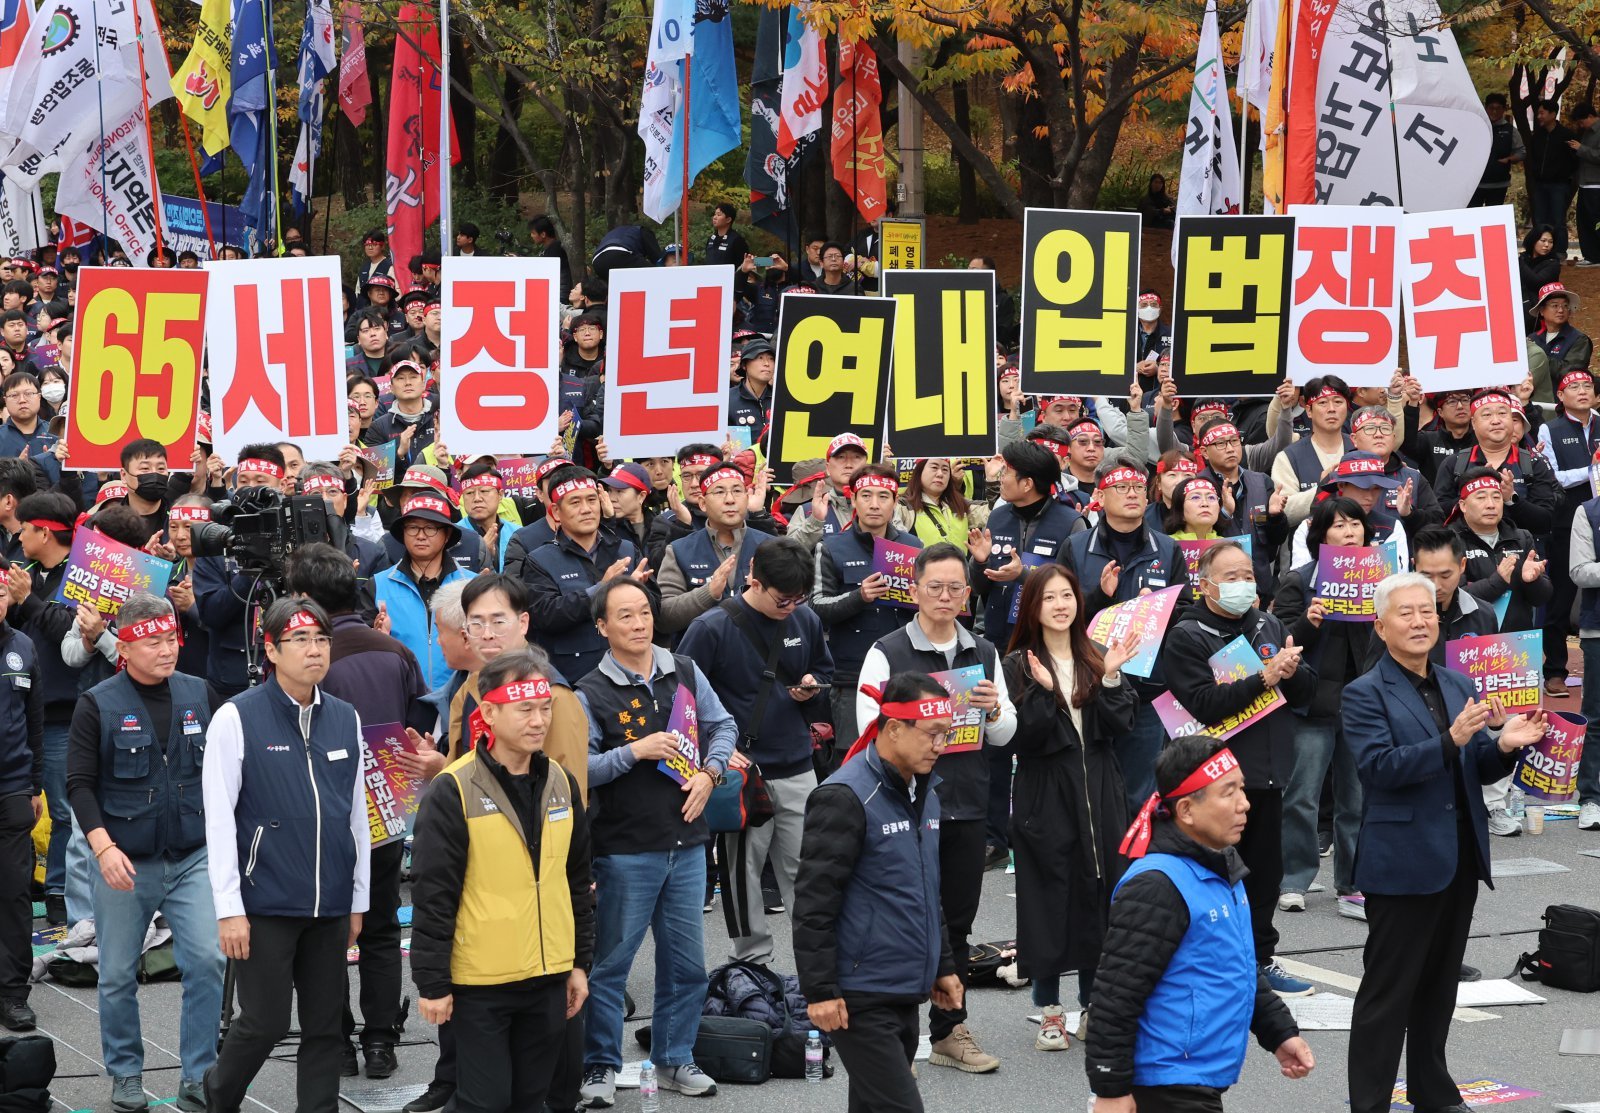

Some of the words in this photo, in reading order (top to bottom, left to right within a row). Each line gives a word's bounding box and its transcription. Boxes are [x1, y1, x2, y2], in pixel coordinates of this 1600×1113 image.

[114, 213, 145, 257] OFFICE
[1033, 229, 1130, 375] 입
[1183, 233, 1285, 375] 법
[1294, 225, 1395, 365] 쟁
[1409, 224, 1518, 369] 취
[222, 277, 338, 437] 세
[451, 278, 549, 431] 정
[617, 286, 723, 436] 년
[892, 289, 988, 436] 내
[76, 287, 201, 446] 65
[781, 315, 885, 463] 연
[1562, 374, 1575, 385] 단결
[1474, 395, 1489, 409] 단결
[1221, 425, 1237, 437] 투쟁
[259, 461, 279, 476] 투쟁
[1350, 461, 1368, 472] 단결
[303, 477, 320, 491] 단결
[506, 477, 523, 488] 다시
[556, 481, 574, 495] 단결
[704, 471, 721, 488] 단결
[729, 469, 745, 483] 투쟁
[856, 476, 872, 488] 단결
[880, 478, 897, 491] 투쟁
[1466, 482, 1481, 493] 단결
[105, 486, 122, 498] 단결
[424, 496, 443, 512] 투쟁
[192, 509, 209, 520] 투쟁
[85, 542, 107, 560] 완전
[107, 552, 136, 572] 새로운,
[885, 550, 905, 565] 완전
[1333, 555, 1357, 569] 완전
[1359, 553, 1384, 567] 새로운,
[67, 564, 100, 591] 2025
[90, 560, 110, 577] 다시
[110, 566, 130, 583] 쓰는
[132, 572, 152, 588] 노동
[894, 566, 914, 578] 다시
[1343, 568, 1365, 582] 다시
[1367, 567, 1383, 579] 쓰는
[1321, 581, 1359, 598] 2025
[132, 620, 156, 638] 단결
[1459, 646, 1480, 664] 완전
[1482, 641, 1512, 658] 새로운,
[1469, 659, 1488, 676] 다시
[1490, 655, 1510, 671] 쓰는
[1511, 651, 1530, 669] 노동
[1485, 669, 1539, 692] 한국노총
[506, 681, 536, 701] 단결
[920, 701, 945, 717] 단결
[951, 707, 982, 726] 노총
[377, 748, 399, 771] 다시
[1525, 745, 1567, 777] 2025
[1550, 745, 1577, 761] 다시
[1203, 758, 1232, 780] 단결
[365, 770, 408, 837] 한국노총
[882, 820, 910, 835] 단결투쟁
